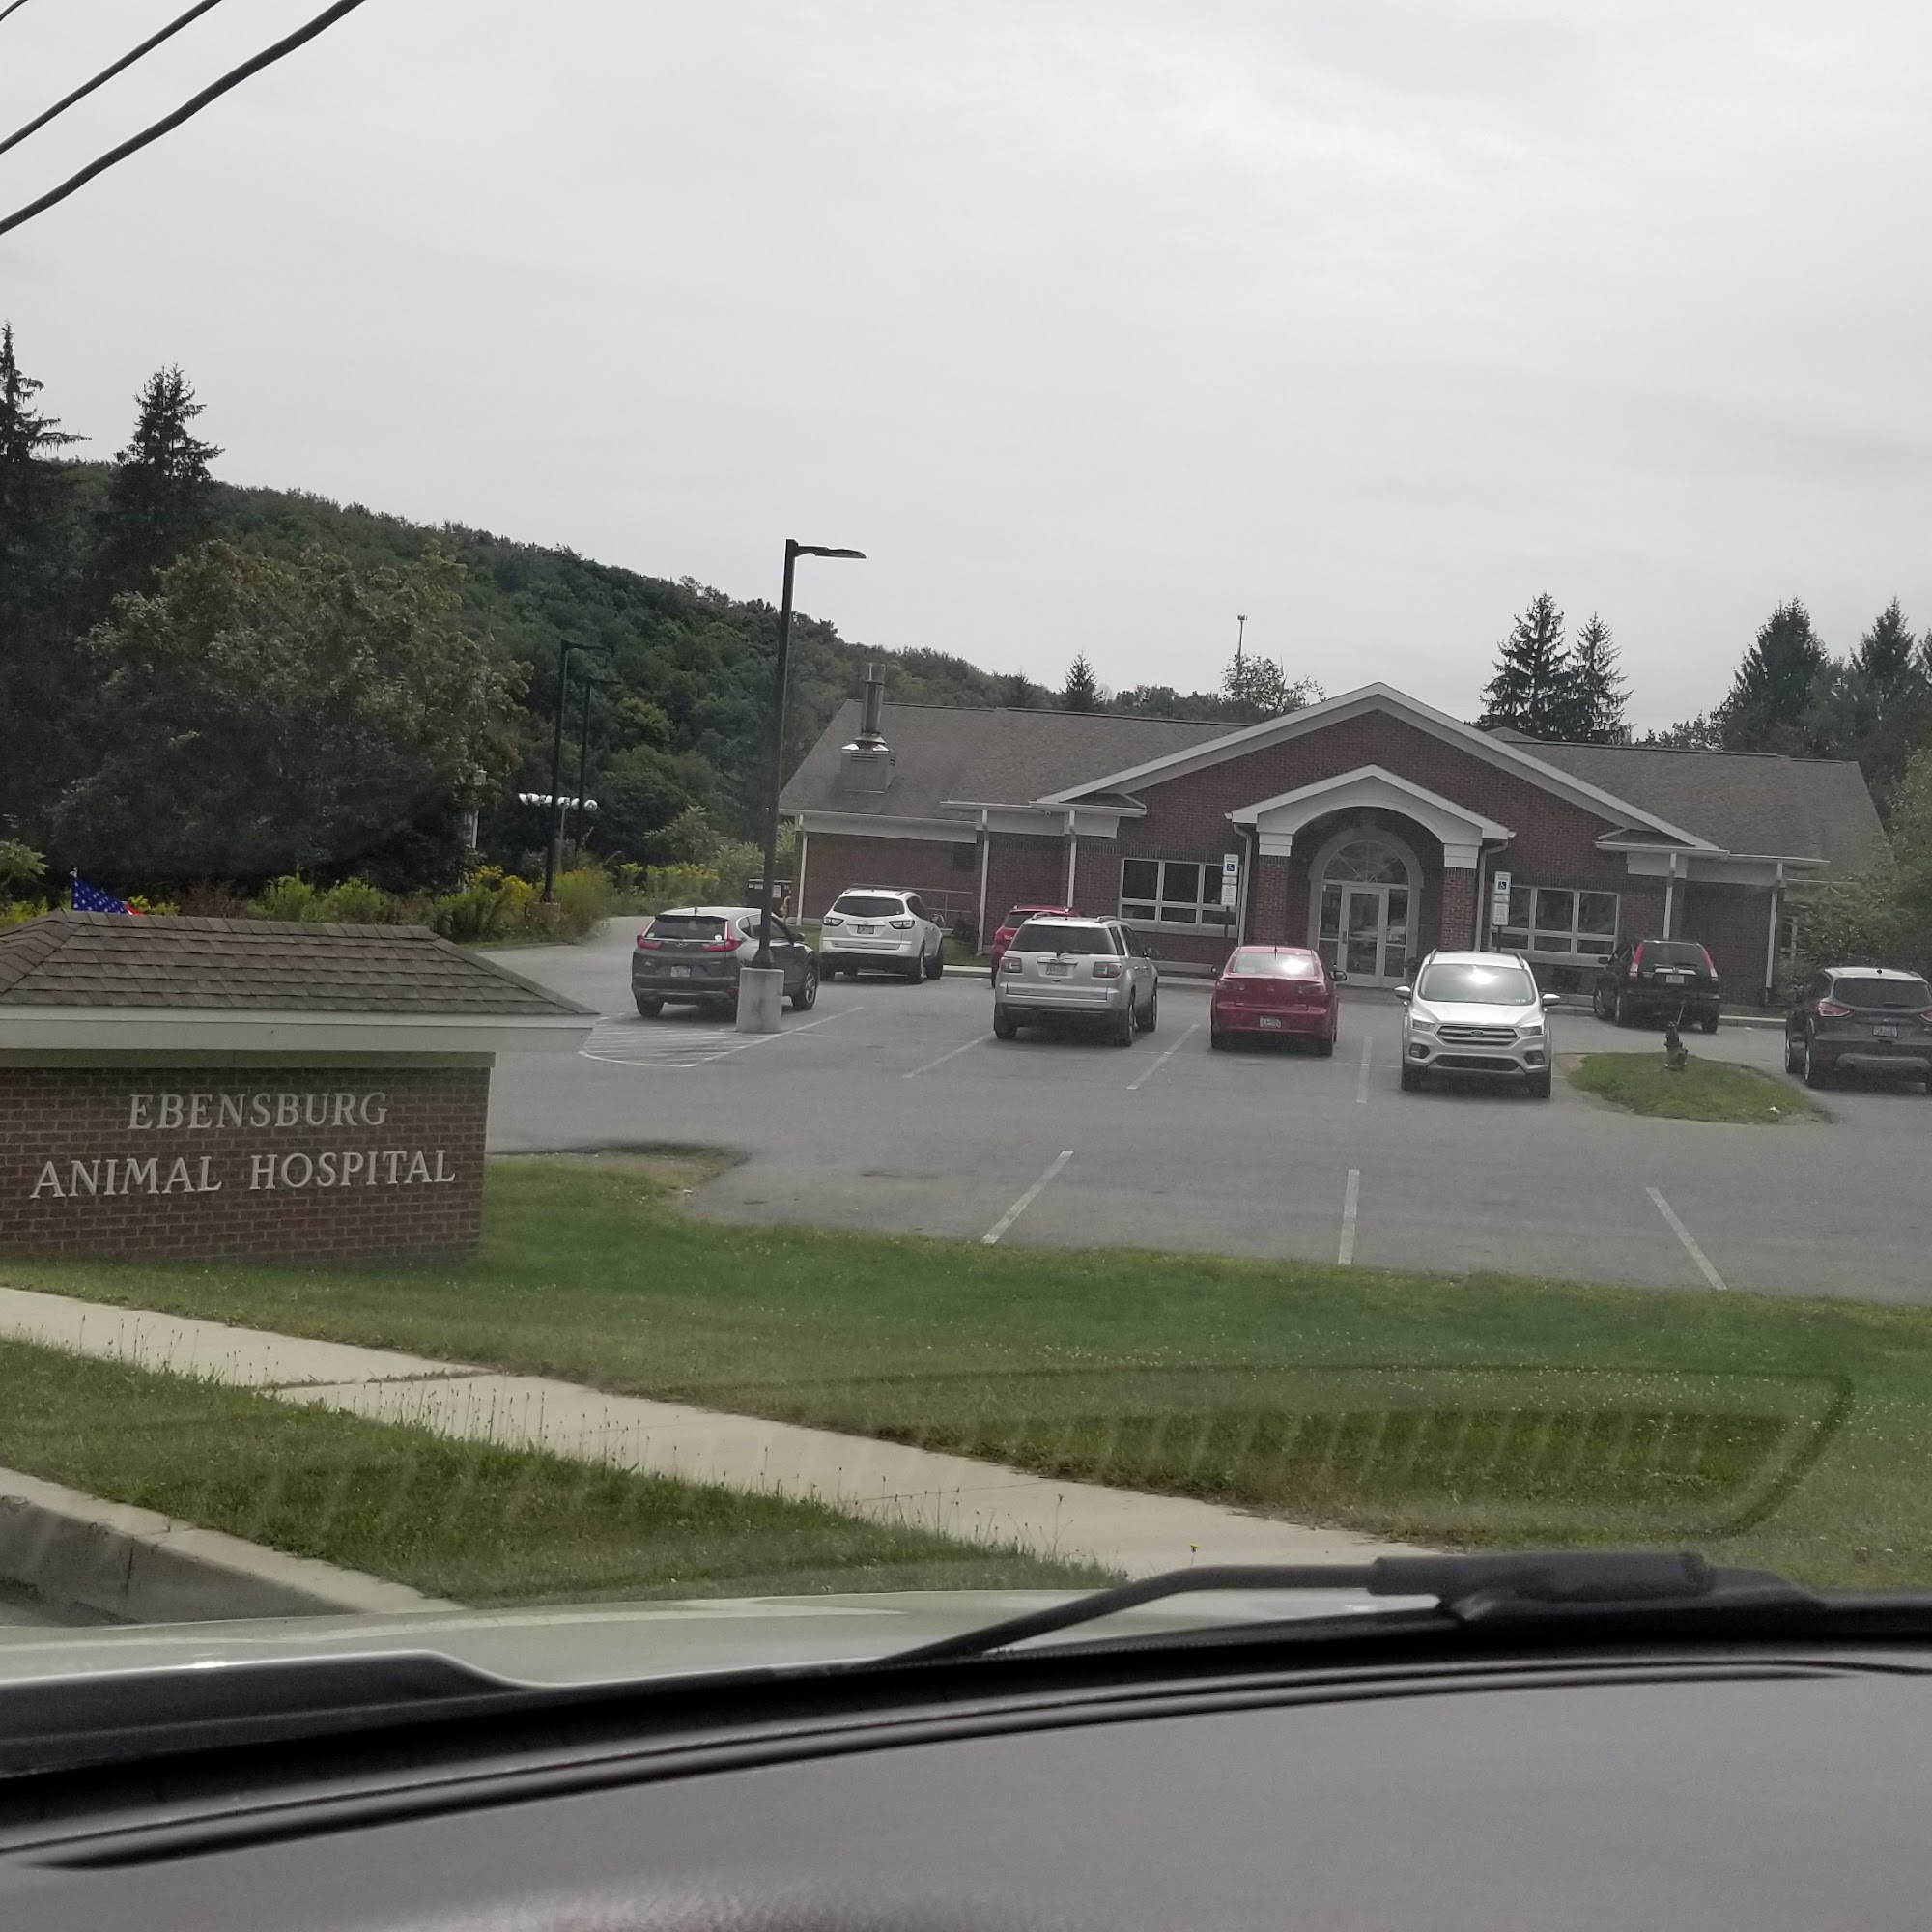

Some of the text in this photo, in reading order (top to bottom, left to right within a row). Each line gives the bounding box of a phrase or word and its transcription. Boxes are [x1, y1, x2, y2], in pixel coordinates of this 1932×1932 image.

[128, 1092, 388, 1129] EBENSBURG
[30, 1150, 456, 1199] ANIMAL HOSPITAL
